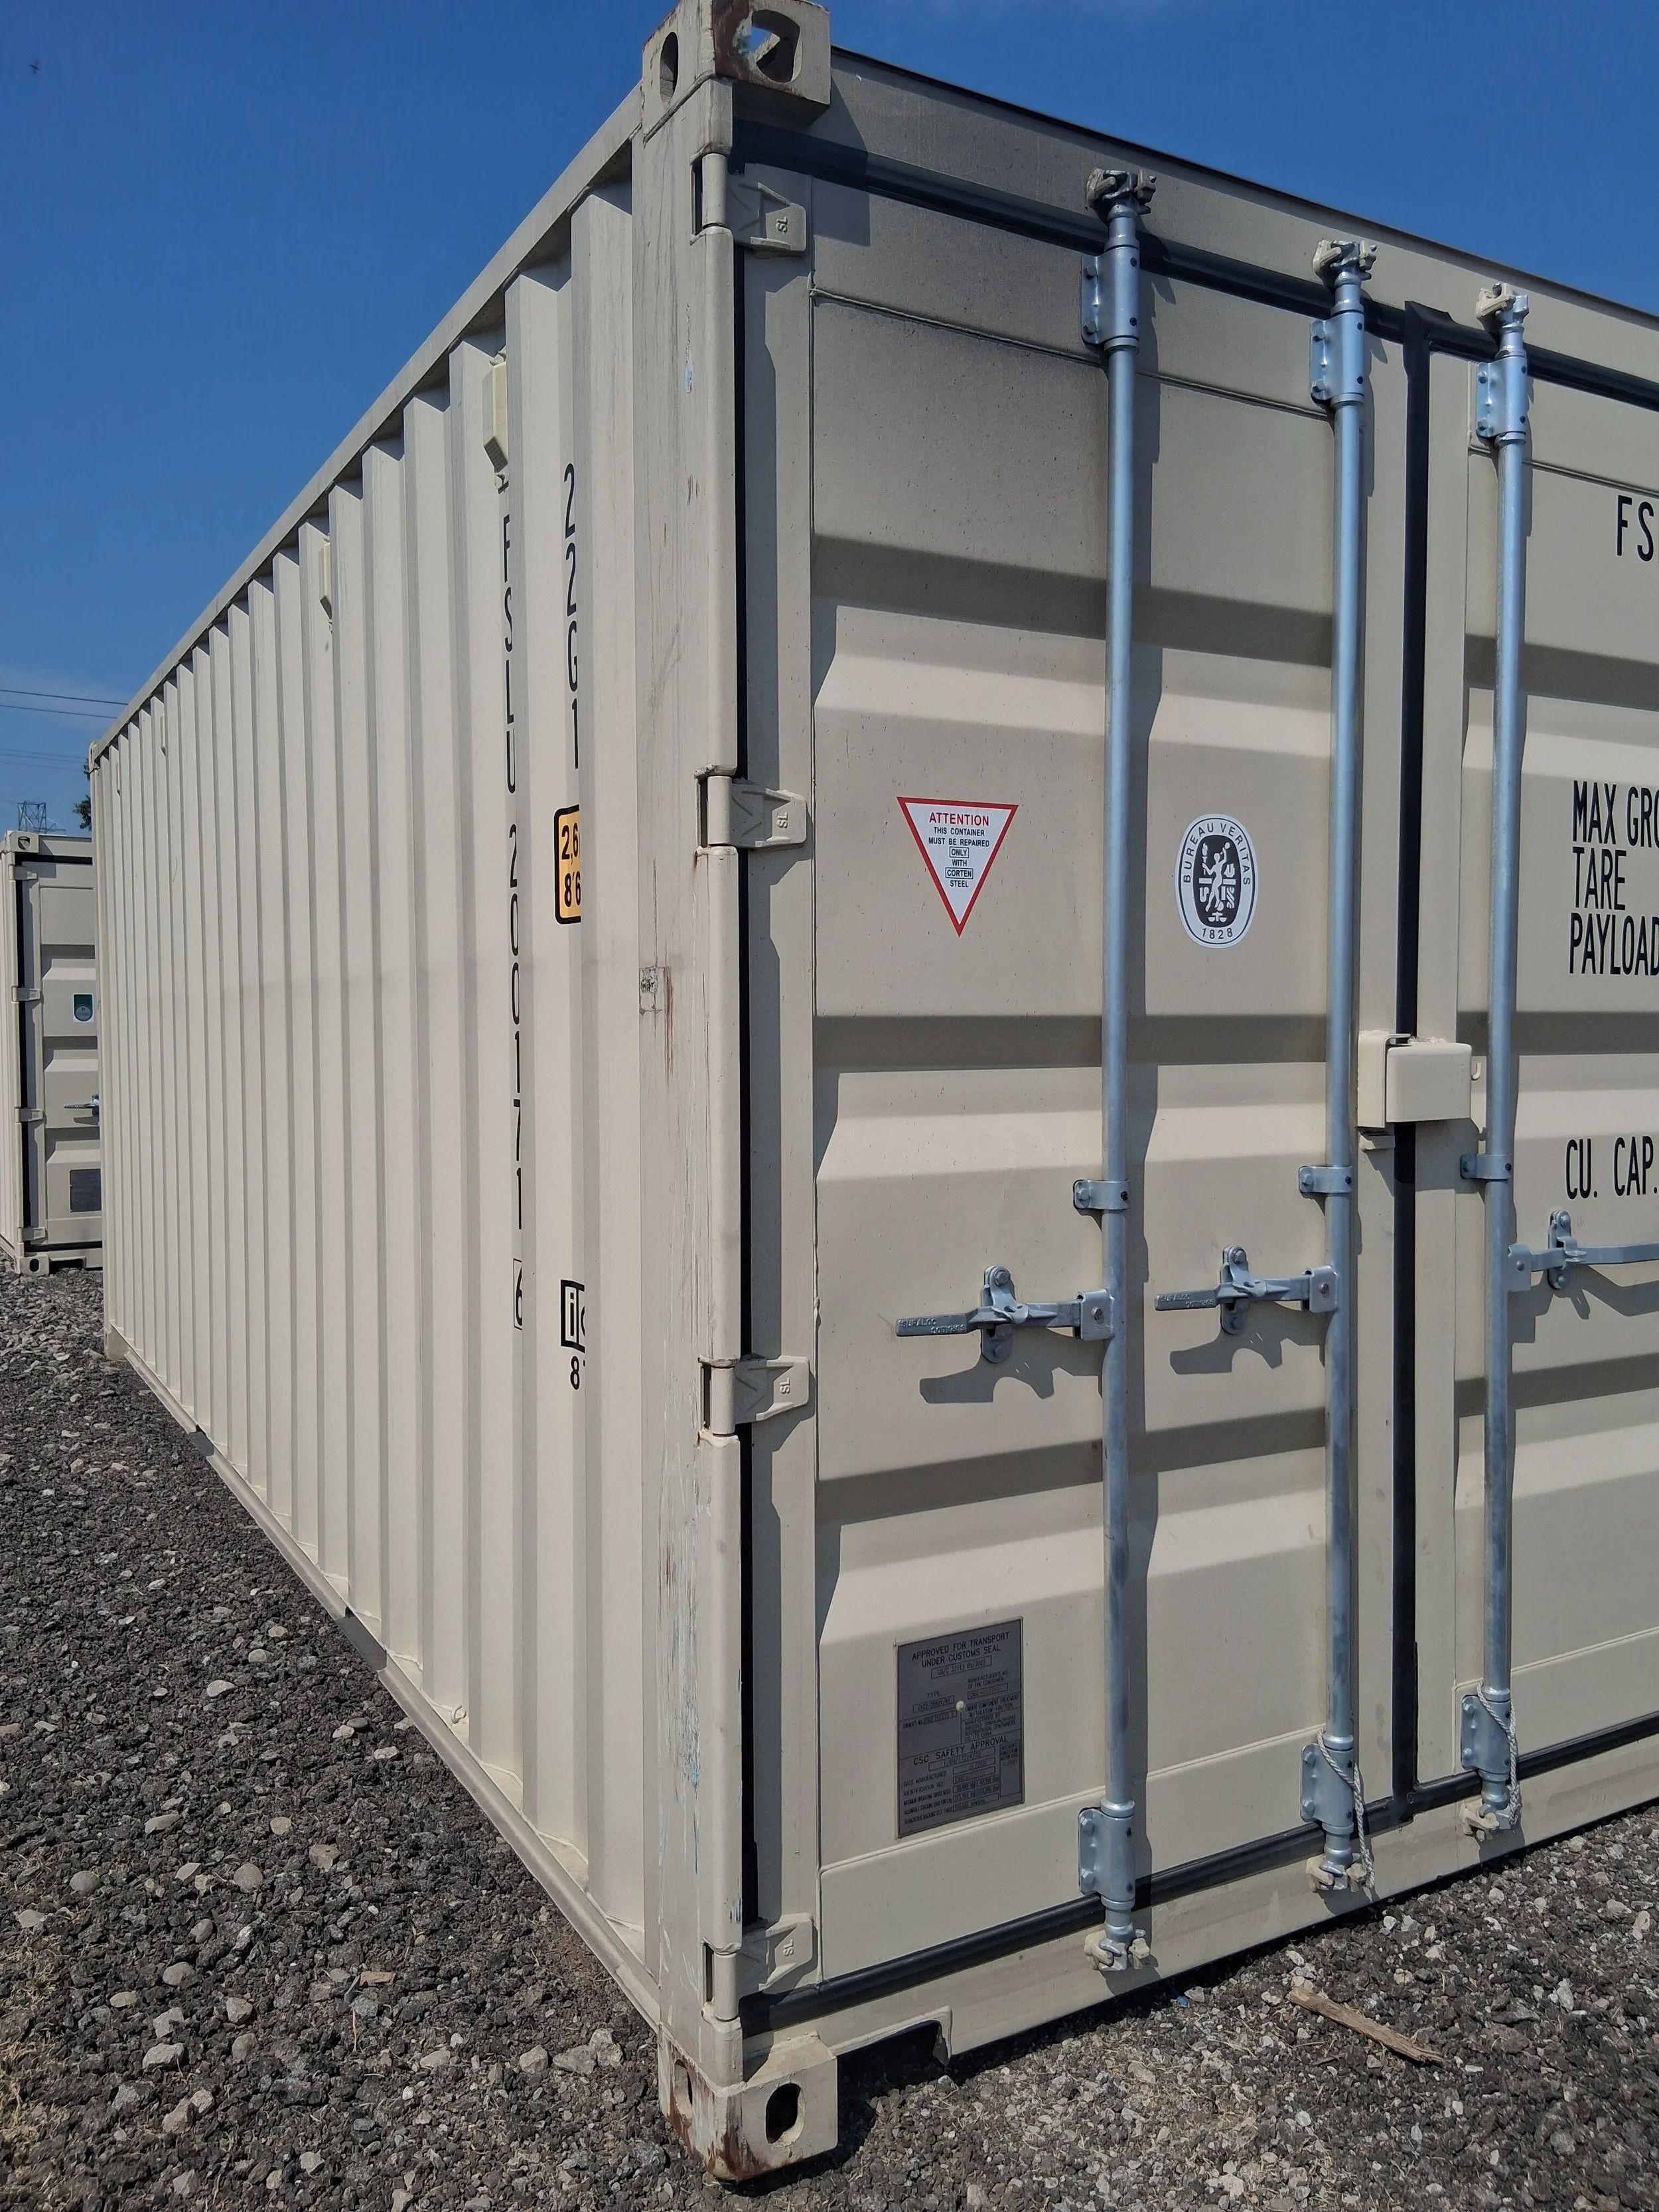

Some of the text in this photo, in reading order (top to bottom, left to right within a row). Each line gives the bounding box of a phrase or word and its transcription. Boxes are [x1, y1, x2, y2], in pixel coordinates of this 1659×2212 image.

[776, 216, 788, 234] SL
[1617, 494, 1654, 561] FS
[563, 463, 579, 770] 22G1
[776, 812, 788, 829] SL
[929, 812, 989, 826] ATTENTION
[1573, 780, 1617, 845] MAX
[950, 828, 985, 837] CONTAINER
[1183, 822, 1251, 885] BUREAU VERITAS
[947, 869, 972, 877] CORTEN
[1573, 846, 1626, 911] TARE
[1202, 927, 1233, 940] 1828
[1569, 912, 1659, 976] PAYLOAD
[1565, 1136, 1658, 1199] CU. CAP.
[780, 1377, 791, 1395] SL
[912, 1632, 1009, 1660] APPROVED FOR TRANSPORT
[922, 1645, 1000, 1668] UNDER CUSTOMS SEAL
[913, 1755, 929, 1765] CSC
[936, 1745, 965, 1759] SAFETY
[970, 1735, 1009, 1751] APPROVAL
[783, 1939, 794, 1957] SL
